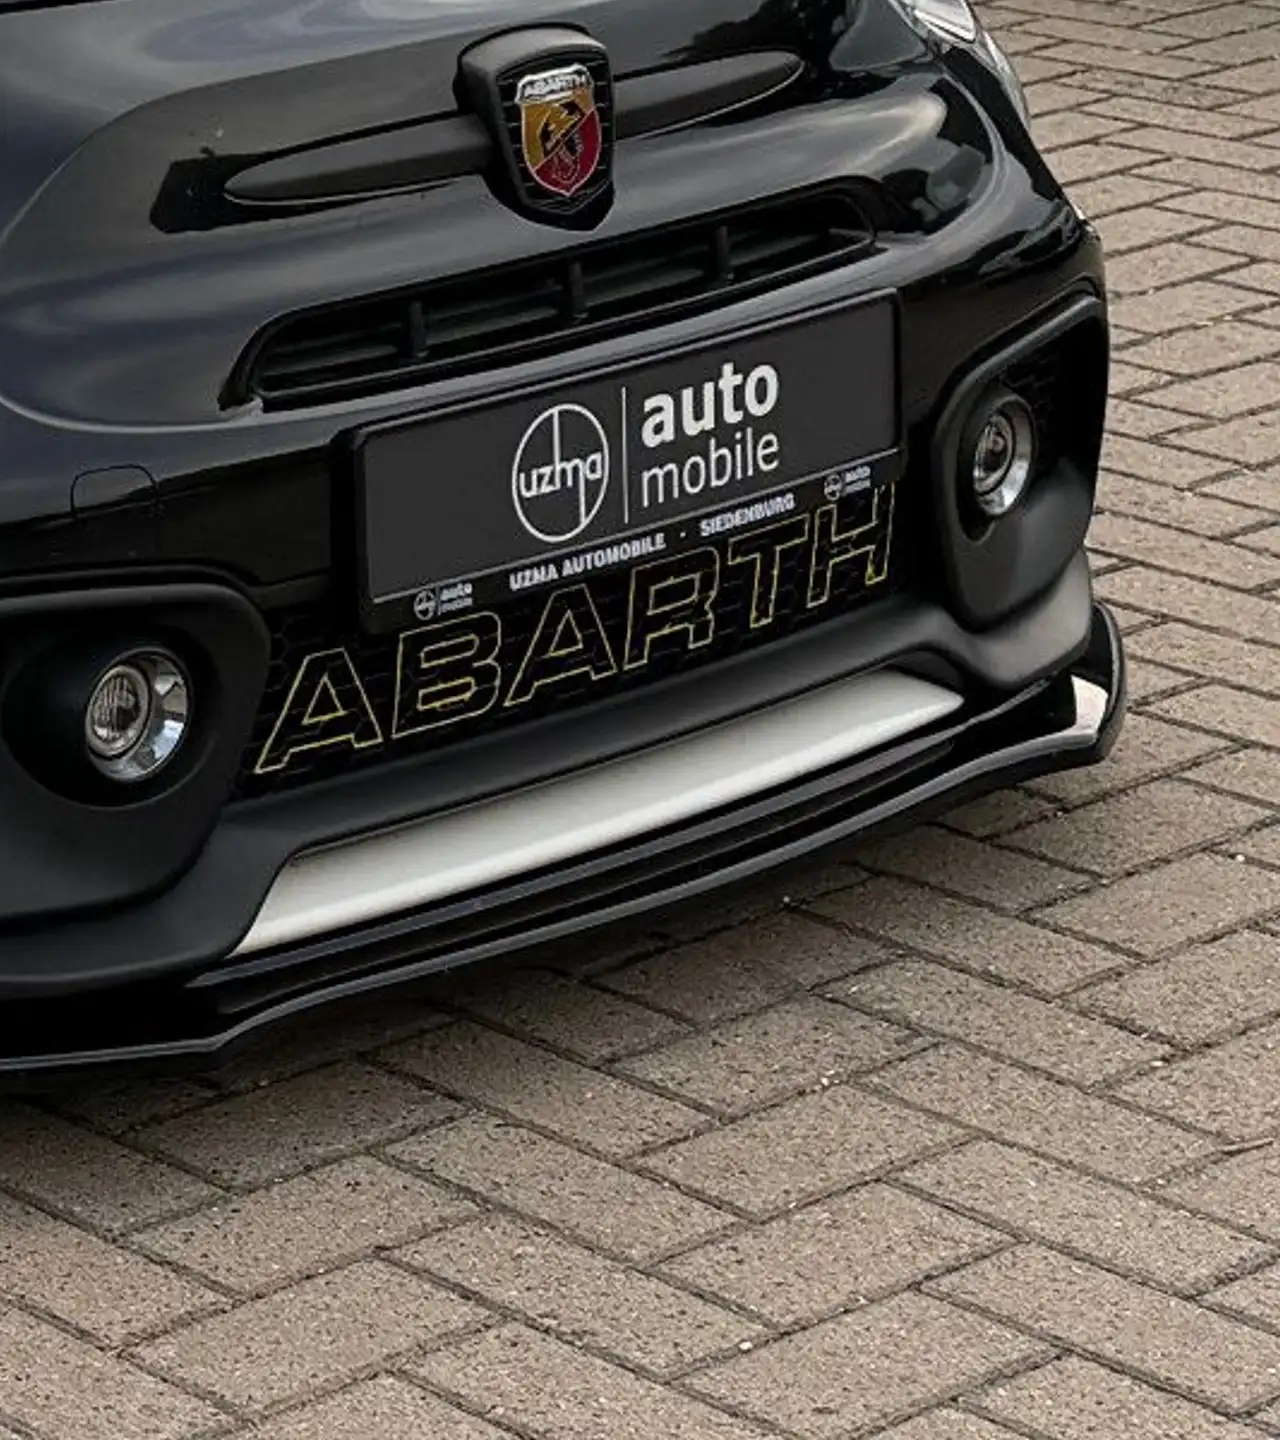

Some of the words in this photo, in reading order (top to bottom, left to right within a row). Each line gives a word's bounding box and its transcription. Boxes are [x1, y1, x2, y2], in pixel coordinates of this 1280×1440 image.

[641, 361, 780, 449] auto
[640, 429, 780, 509] mobile
[508, 562, 559, 592] UZMA
[561, 532, 667, 577] AUTOMOBILE
[699, 491, 796, 537] SIEDENBURG
[253, 484, 895, 774] ABARTH
